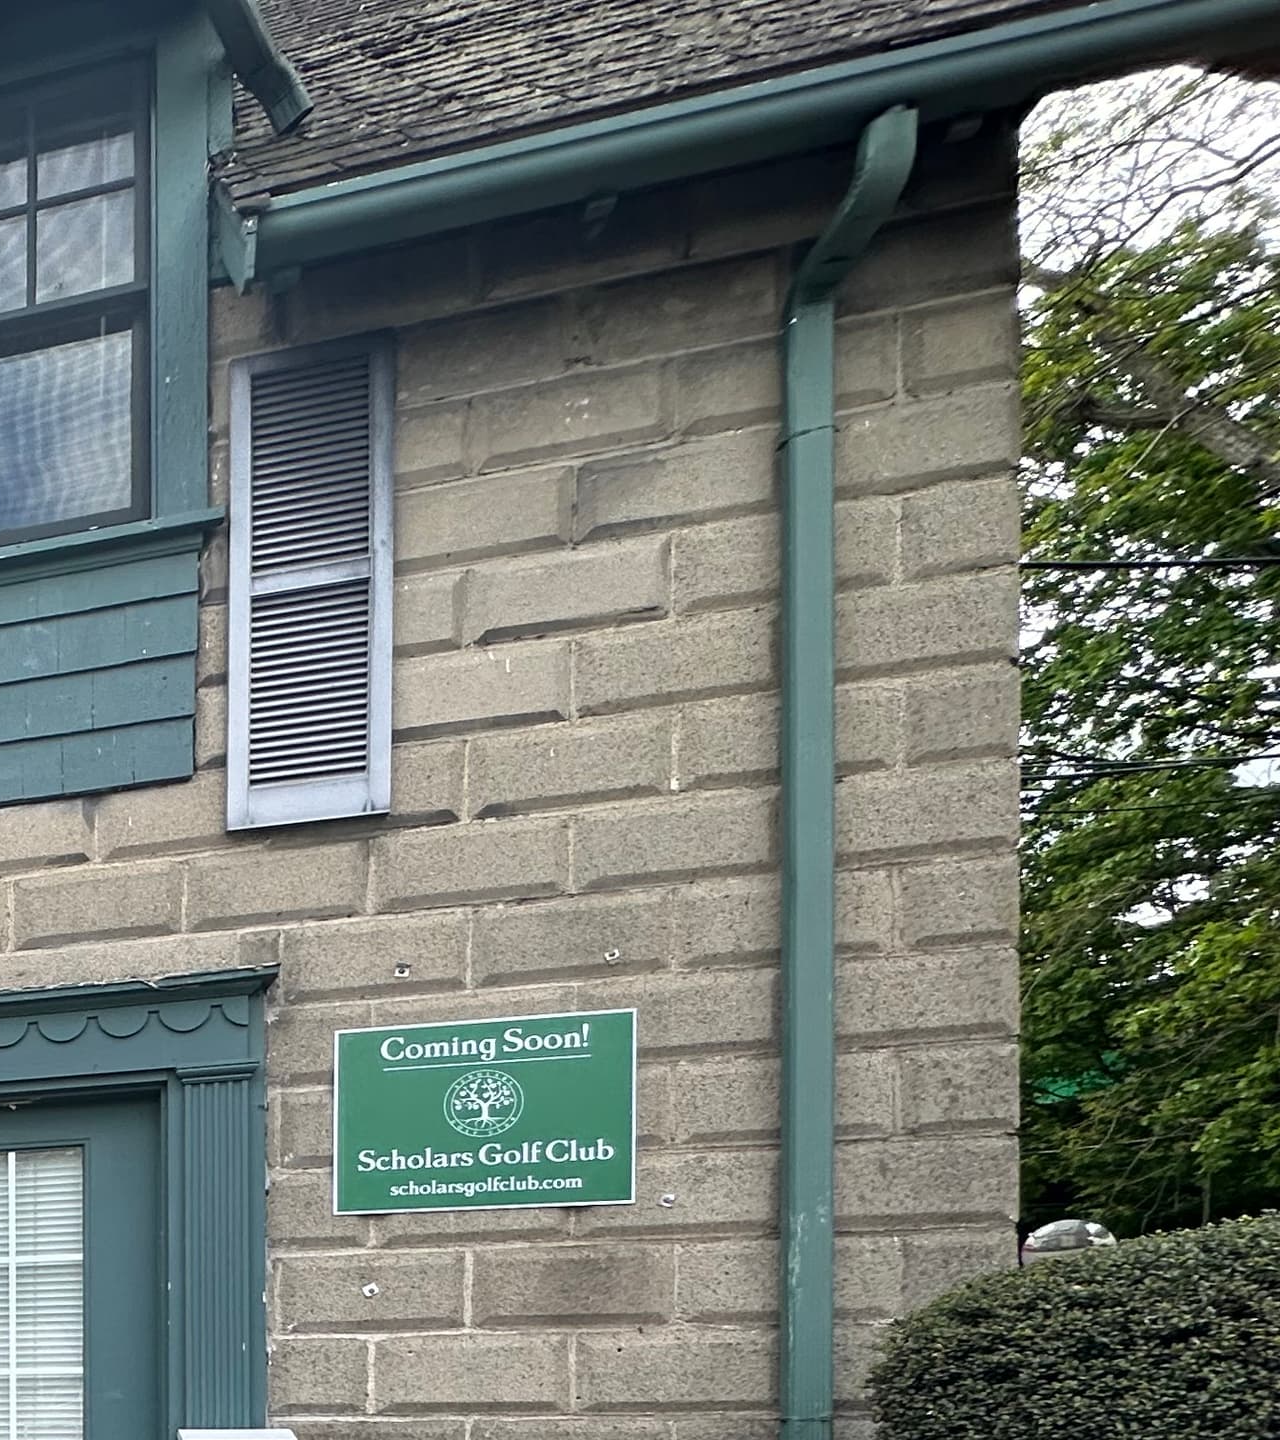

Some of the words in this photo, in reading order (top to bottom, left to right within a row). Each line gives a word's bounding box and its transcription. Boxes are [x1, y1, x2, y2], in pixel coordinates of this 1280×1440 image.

[379, 1036, 497, 1062] Coming
[502, 1023, 590, 1053] Soon!
[357, 1146, 474, 1173] Scholars
[477, 1141, 543, 1167] Golf
[545, 1138, 615, 1163] Club
[389, 1176, 583, 1197] scholarsgolfclub.com
